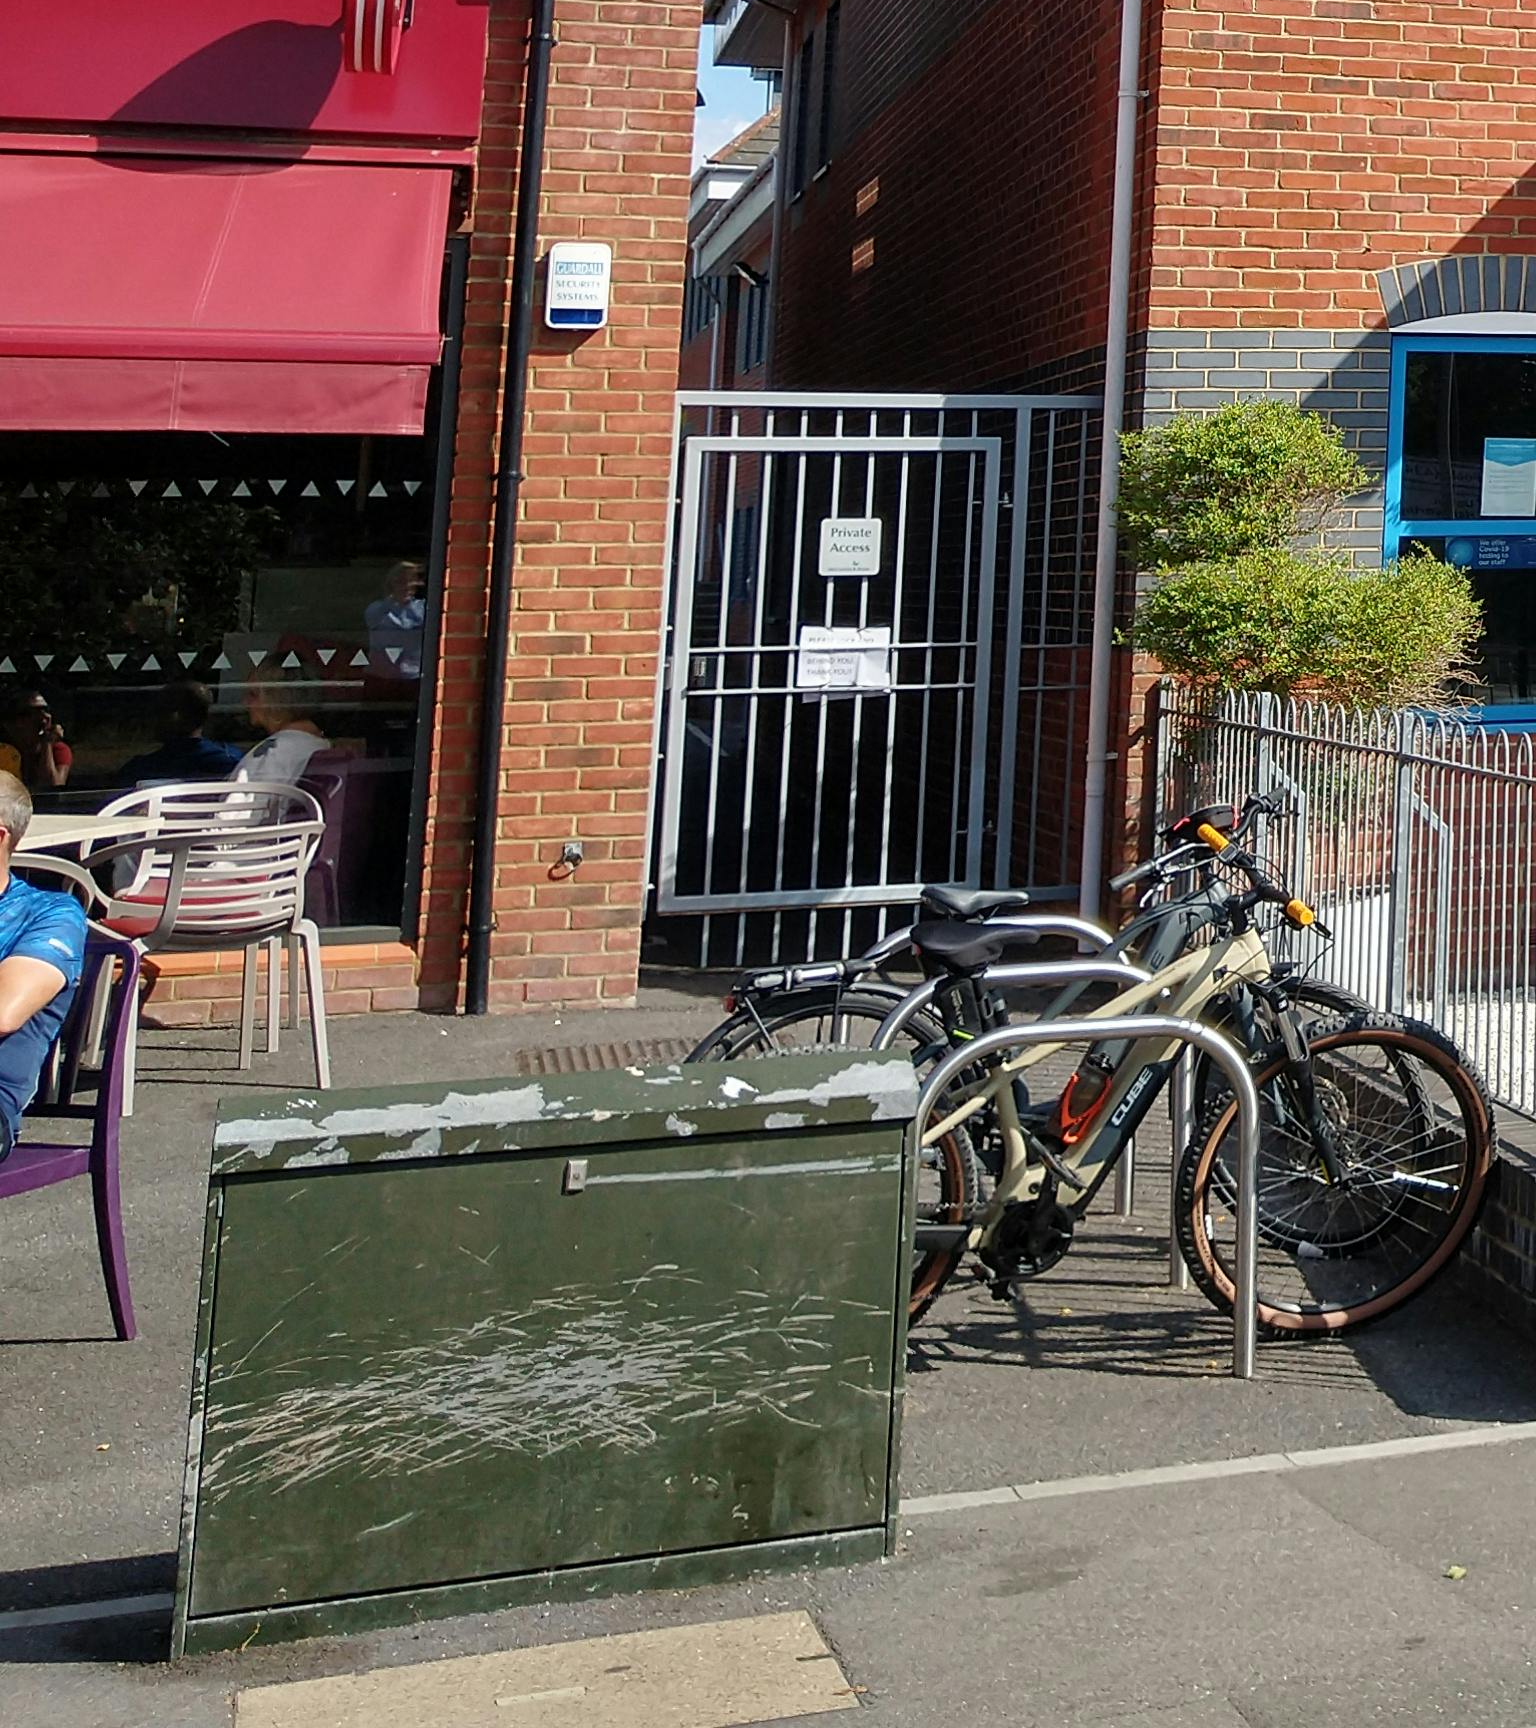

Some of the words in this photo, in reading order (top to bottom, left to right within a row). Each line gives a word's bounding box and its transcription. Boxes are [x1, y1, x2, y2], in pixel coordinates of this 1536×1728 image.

[831, 527, 872, 538] Private
[830, 543, 871, 553] Access
[1110, 1065, 1152, 1127] CUBE
